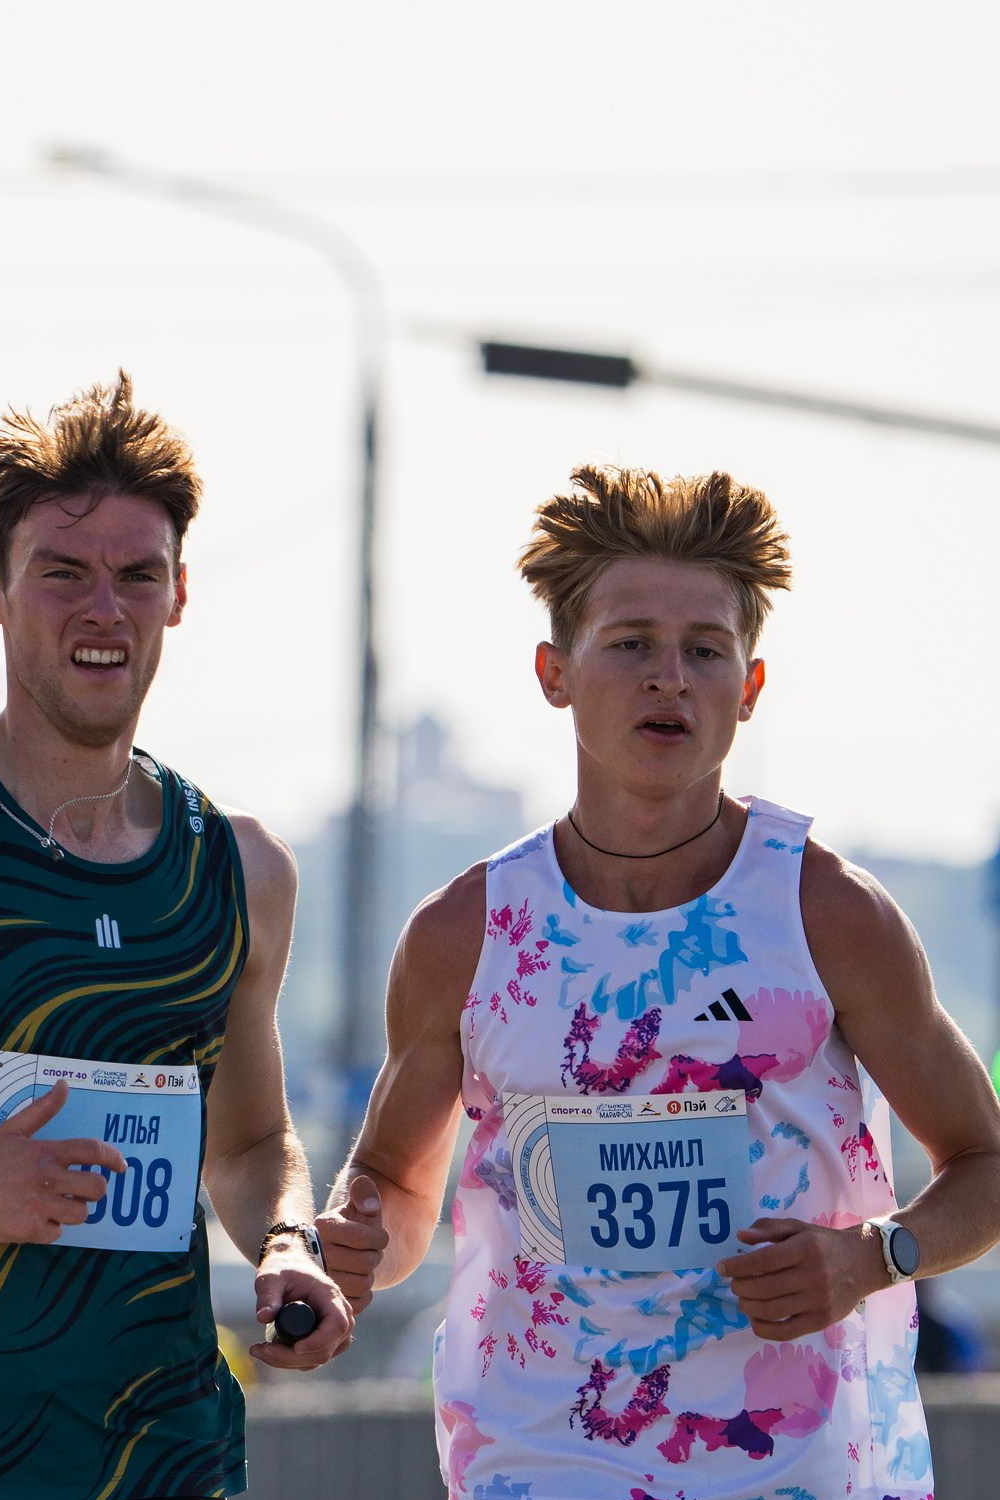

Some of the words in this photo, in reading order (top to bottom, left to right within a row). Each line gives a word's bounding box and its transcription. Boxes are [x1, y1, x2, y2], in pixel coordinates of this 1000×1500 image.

[43, 1068, 74, 1079] СПОРТ
[75, 1072, 87, 1080] 40
[93, 1077, 127, 1087] МАРАФОН
[167, 1075, 184, 1087] Пэй
[684, 1100, 707, 1112] Пэй
[600, 1110, 633, 1119] МАРАФОН
[103, 1113, 161, 1145] ИЛЬЯ
[599, 1138, 705, 1172] МИХАИЛ
[586, 1177, 731, 1250] 3375
